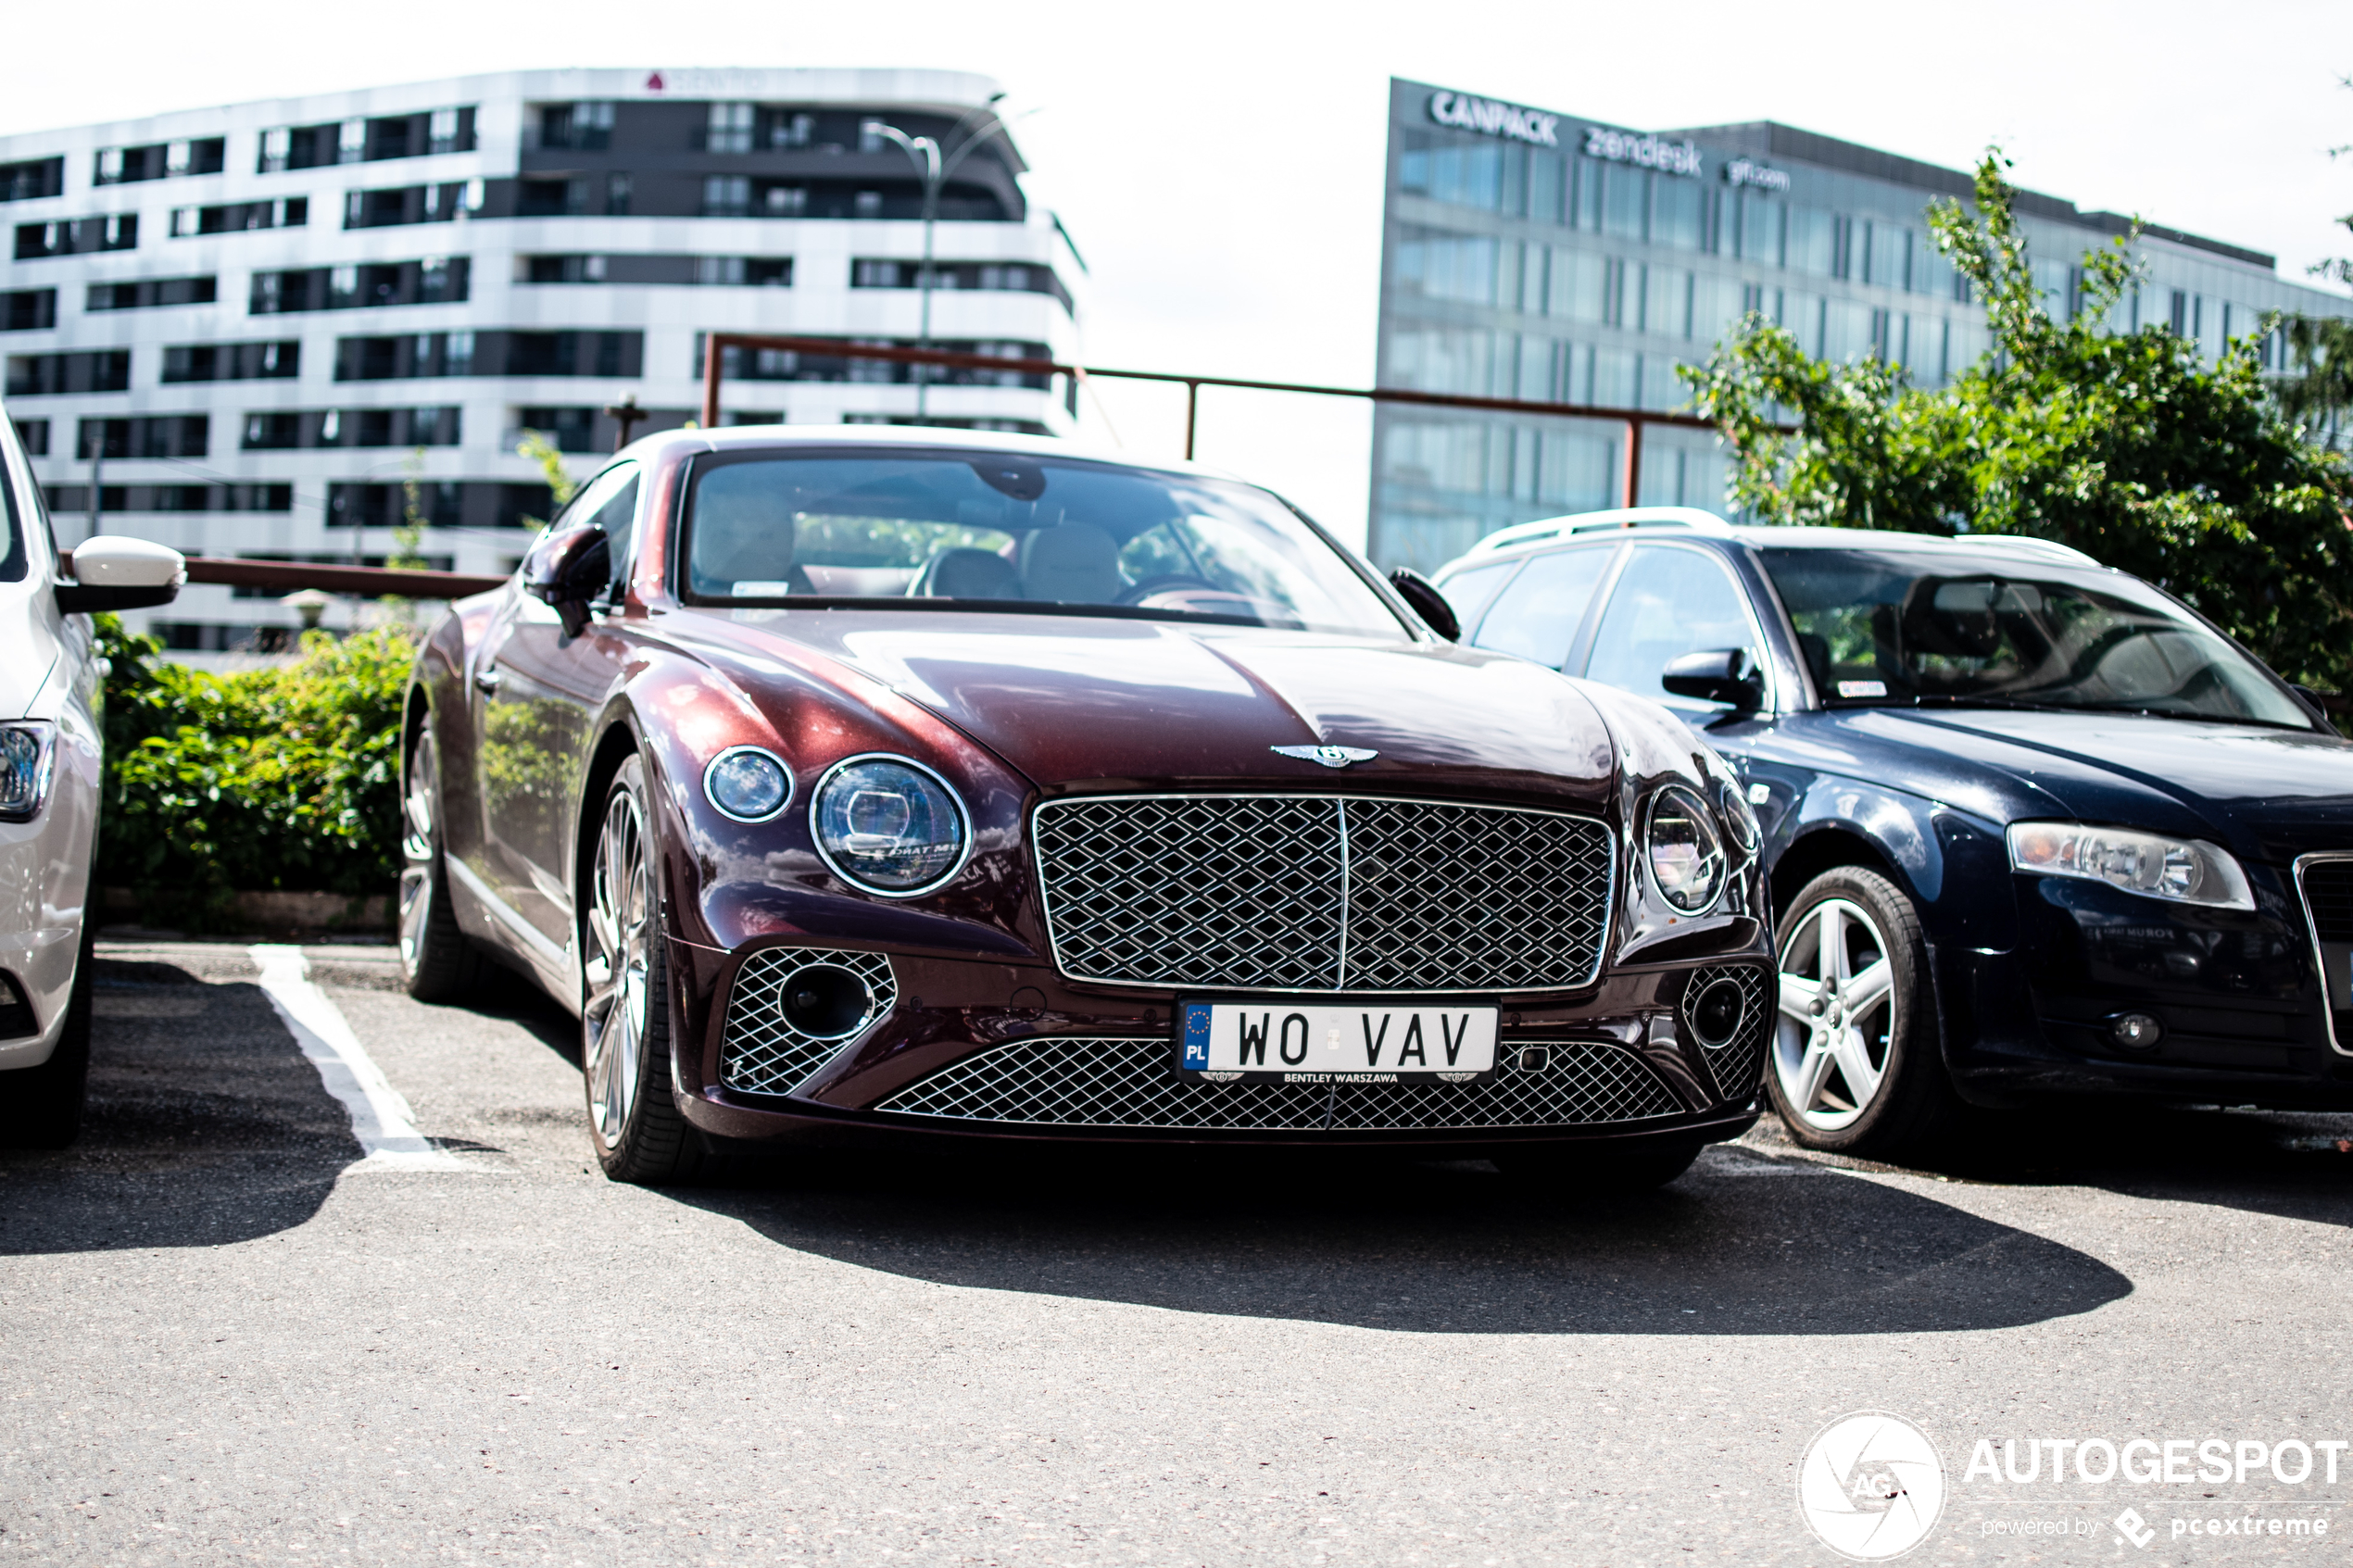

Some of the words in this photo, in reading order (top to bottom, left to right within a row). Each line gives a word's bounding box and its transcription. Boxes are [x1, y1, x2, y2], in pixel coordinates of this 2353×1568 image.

[1431, 91, 1558, 147] CANPACK
[1586, 127, 1703, 177] zendesk
[1186, 1045, 1206, 1060] PL
[1239, 1012, 1310, 1066] WO
[1362, 1013, 1470, 1067] VAV
[1284, 1073, 1332, 1083] BENTLEY
[1334, 1073, 1399, 1083] WARSZAWA
